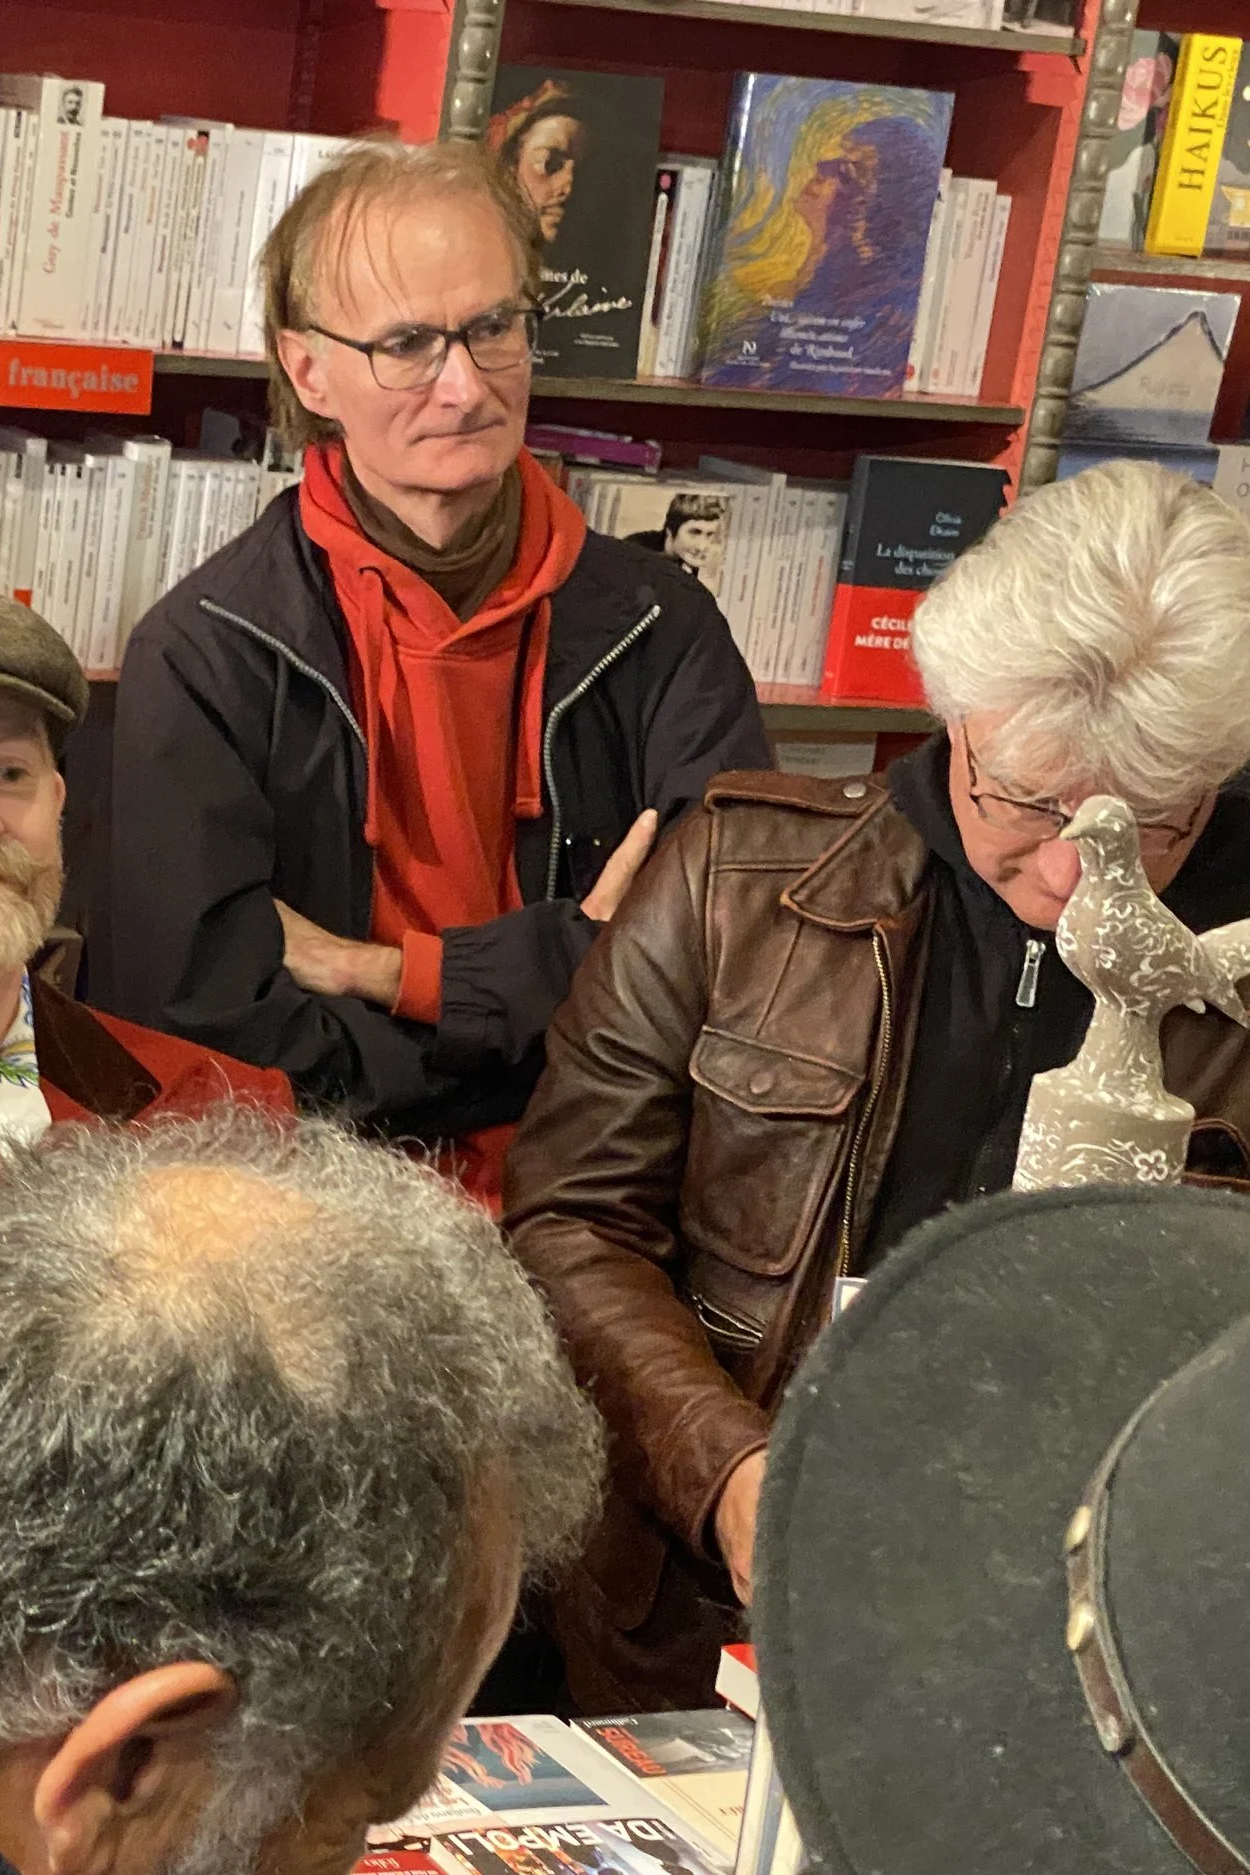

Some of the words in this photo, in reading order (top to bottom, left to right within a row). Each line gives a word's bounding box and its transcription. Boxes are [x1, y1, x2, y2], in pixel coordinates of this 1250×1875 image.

[1178, 45, 1228, 191] HAIKUS
[8, 356, 140, 400] française
[876, 543, 891, 558] La
[448, 1821, 604, 1856] EMPOLI
